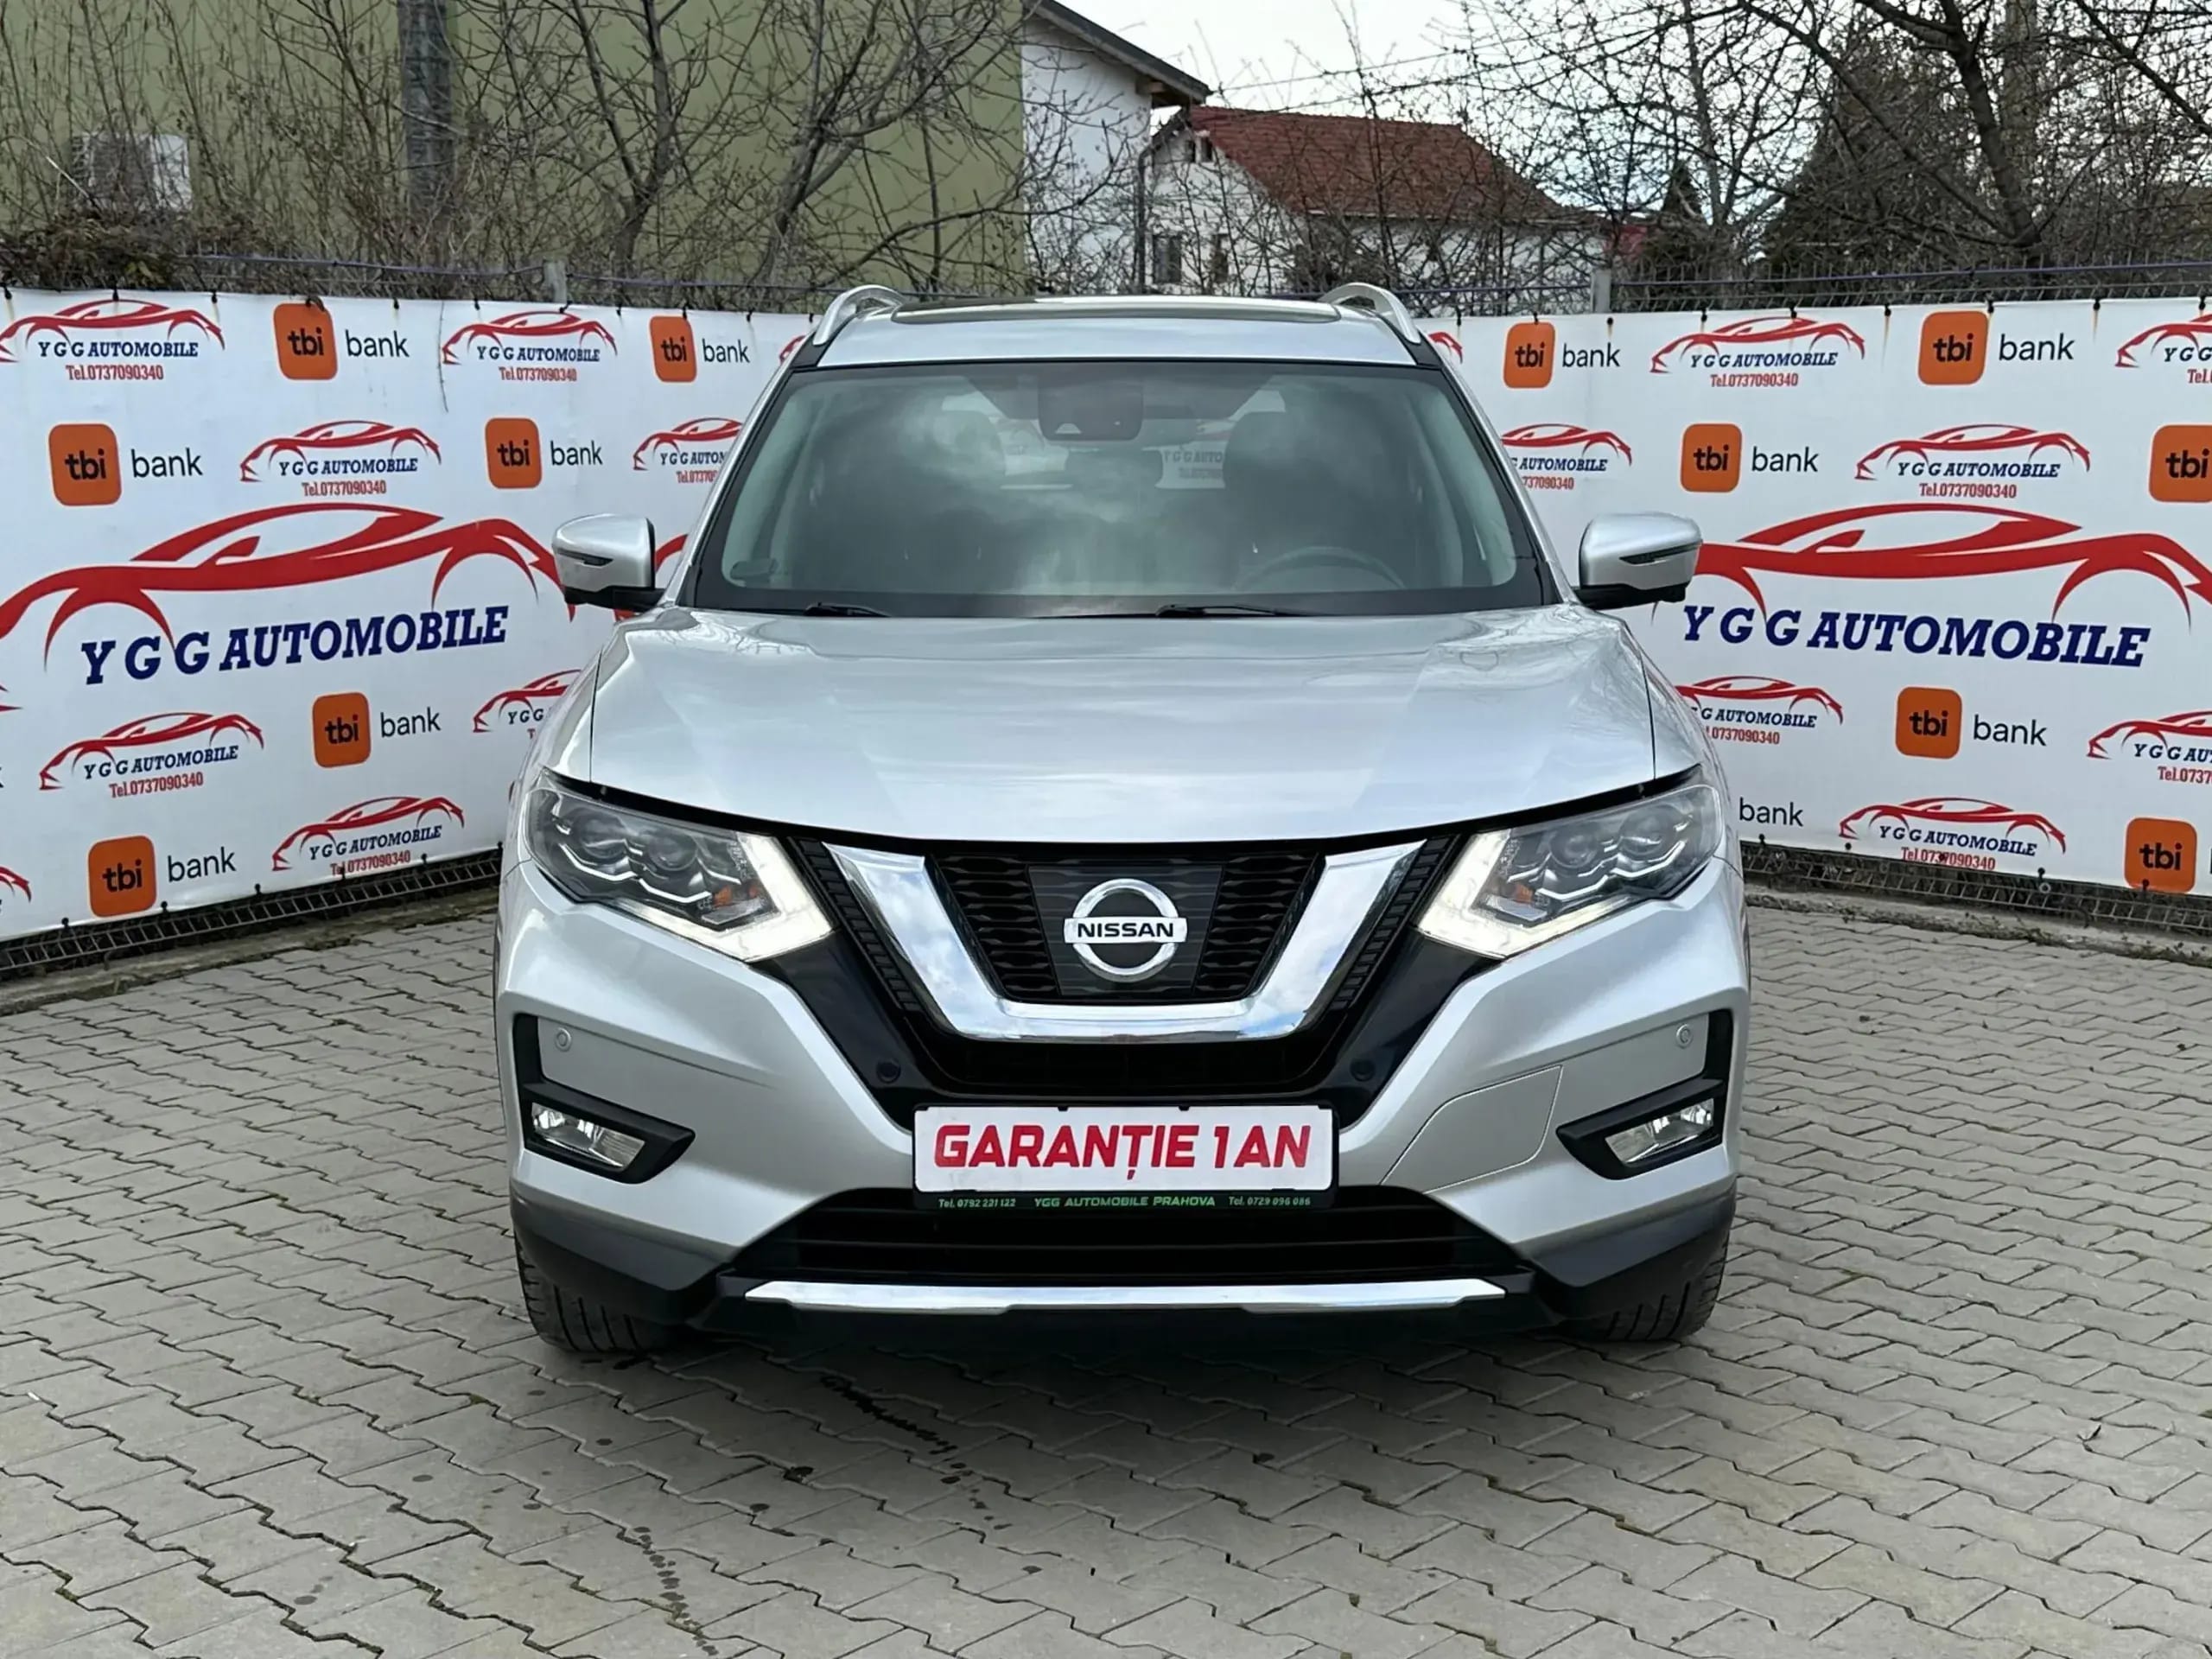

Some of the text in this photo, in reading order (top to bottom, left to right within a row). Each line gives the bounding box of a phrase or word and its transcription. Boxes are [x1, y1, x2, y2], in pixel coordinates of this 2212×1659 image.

[88, 341, 199, 358] AUTOMOBILE
[288, 327, 409, 357] tbi bank
[518, 347, 599, 361] AUTOMOBILE
[661, 337, 749, 363] tbi bank
[1515, 343, 1619, 367] tbi bank
[1933, 334, 2075, 361] tbi bank
[1732, 353, 1838, 367] AUTOMOBILE
[65, 448, 202, 480] tbi bank
[322, 457, 418, 474] AUTOMOBILE
[497, 440, 602, 467] tbi bank
[1519, 458, 1608, 471] AUTOMOBILE
[1694, 446, 1819, 472] tbi bank
[2165, 448, 2209, 478] tbi
[1522, 476, 1574, 489] 737090340
[1944, 463, 2061, 478] AUTOMOBILE
[219, 606, 509, 671] AUTOMOBILE
[1807, 612, 2152, 667] AUTOMOBILE
[325, 707, 442, 744] tbi bank
[1715, 709, 1817, 728] AUTOMOBILE
[1910, 709, 2046, 746] tbi bank
[131, 746, 238, 773] AUTOMOBILE
[2158, 766, 2212, 784] Tel.0737
[1739, 798, 1804, 826] bank
[349, 825, 442, 853] AUTOMOBILE
[1924, 830, 2037, 856] AUTOMOBILE
[2139, 843, 2183, 870] tbi
[102, 847, 236, 893] tbi bank
[1077, 923, 1173, 938] NISSAN
[934, 1125, 1199, 1180] GARANȚIE
[1034, 1197, 1215, 1207] YGG AUTOMOBILE PRAHOVA
